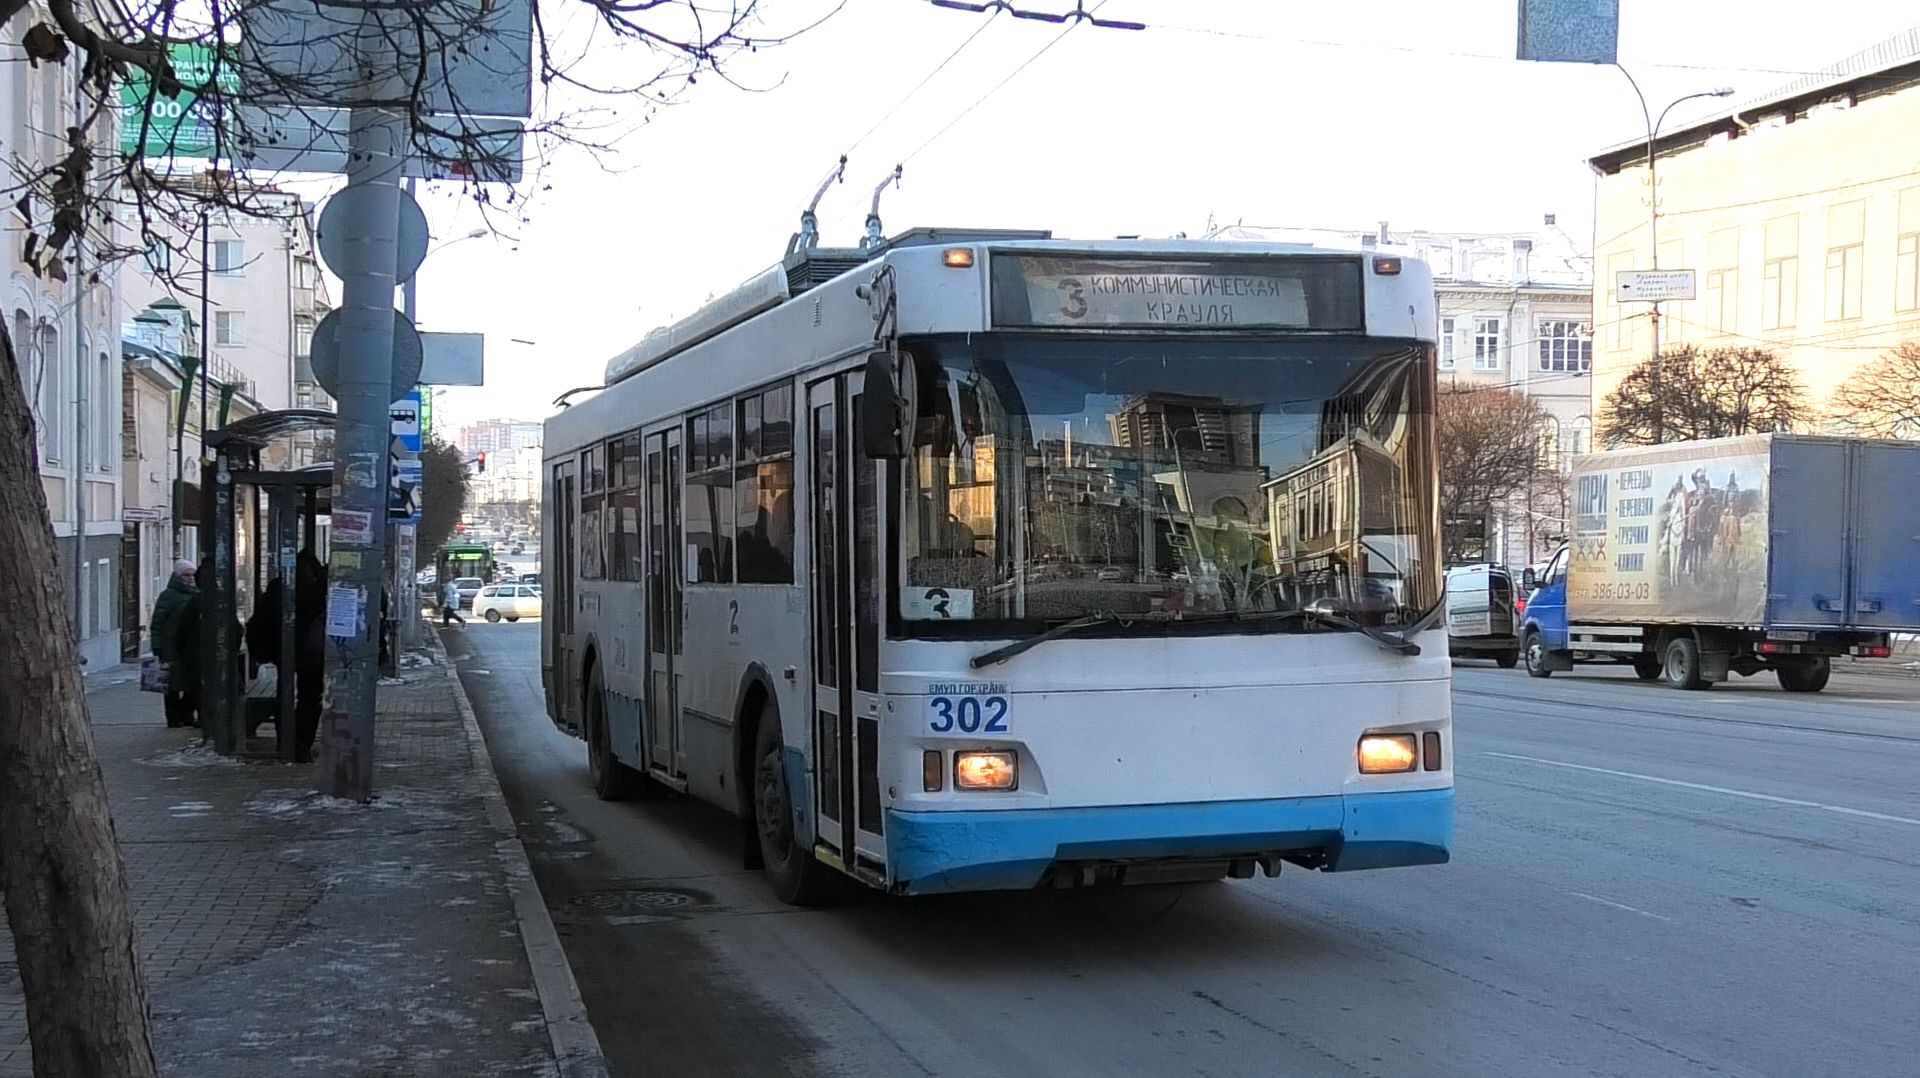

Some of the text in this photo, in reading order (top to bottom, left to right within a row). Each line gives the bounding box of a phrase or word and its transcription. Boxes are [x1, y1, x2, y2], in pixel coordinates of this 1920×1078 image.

[1058, 276, 1280, 319] 3 КОММУНИСТИЧЕСКАЯ
[1147, 301, 1234, 323] КРАУЛЯ
[1591, 583, 1650, 601] 386-03-03
[929, 696, 1008, 733] 302
